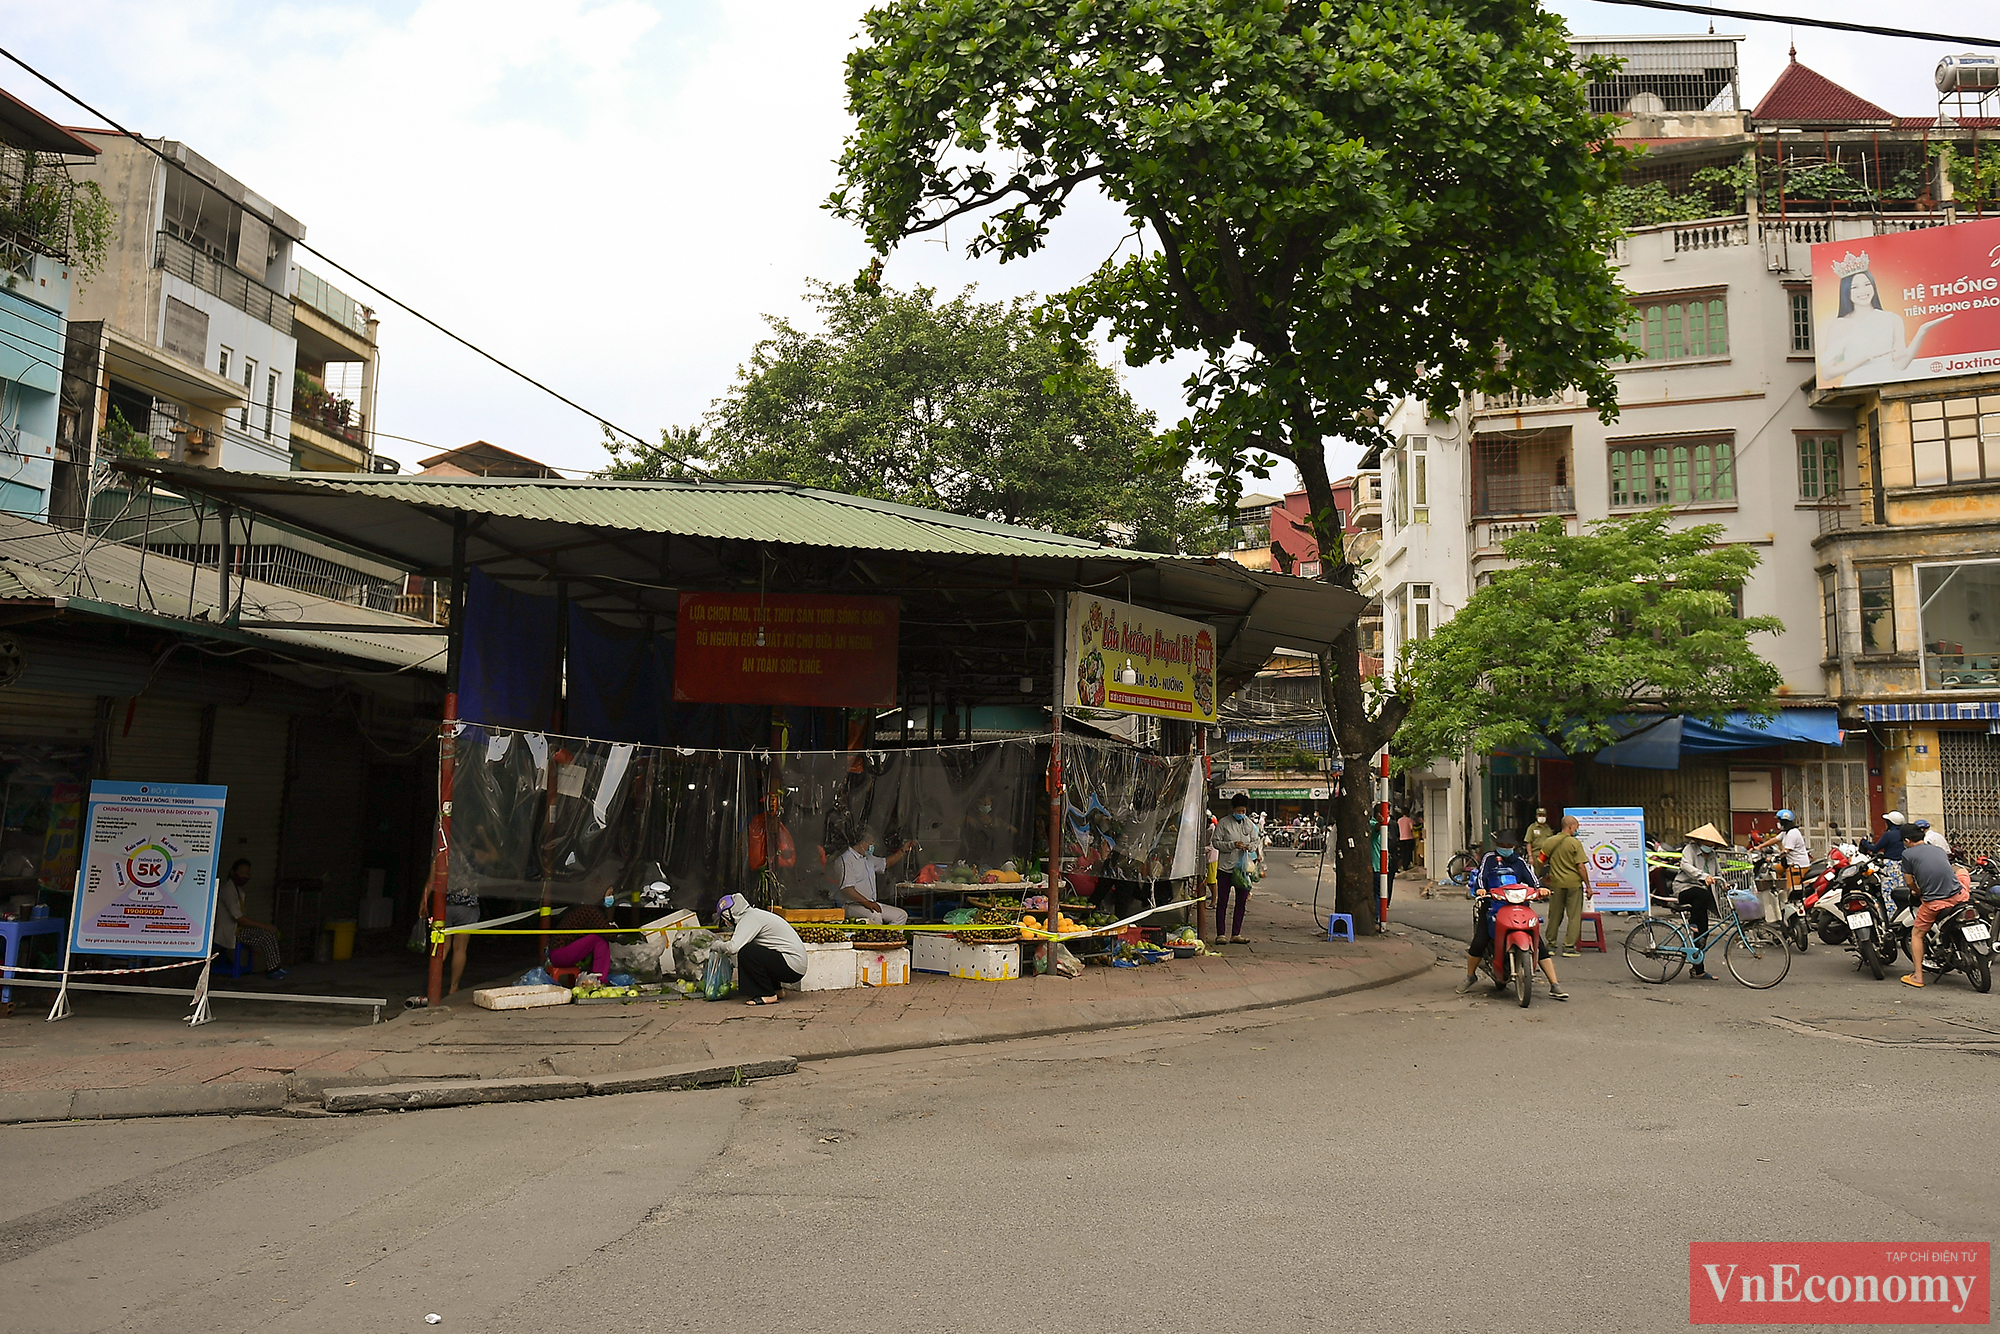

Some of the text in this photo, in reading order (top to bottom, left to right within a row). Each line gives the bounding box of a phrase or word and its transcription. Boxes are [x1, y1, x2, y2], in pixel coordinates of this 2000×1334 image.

[1902, 275, 1998, 303] HỆ THỐNG
[1904, 296, 2000, 317] TIÊN PHONG ĐÀO
[689, 604, 705, 624] LỰA
[707, 606, 730, 624] CHỌN
[732, 606, 751, 623] RAU,
[837, 605, 859, 625] SỐNG
[710, 627, 739, 647] NGUỒN
[762, 628, 781, 647] UẤT
[797, 632, 813, 649] CHO
[742, 657, 755, 673] AN
[756, 655, 778, 673] TOÀN
[780, 655, 797, 674] SỨC
[120, 795, 141, 803] ĐƯỜNG
[137, 863, 162, 876] 5K
[1600, 855, 1613, 864] 5K
